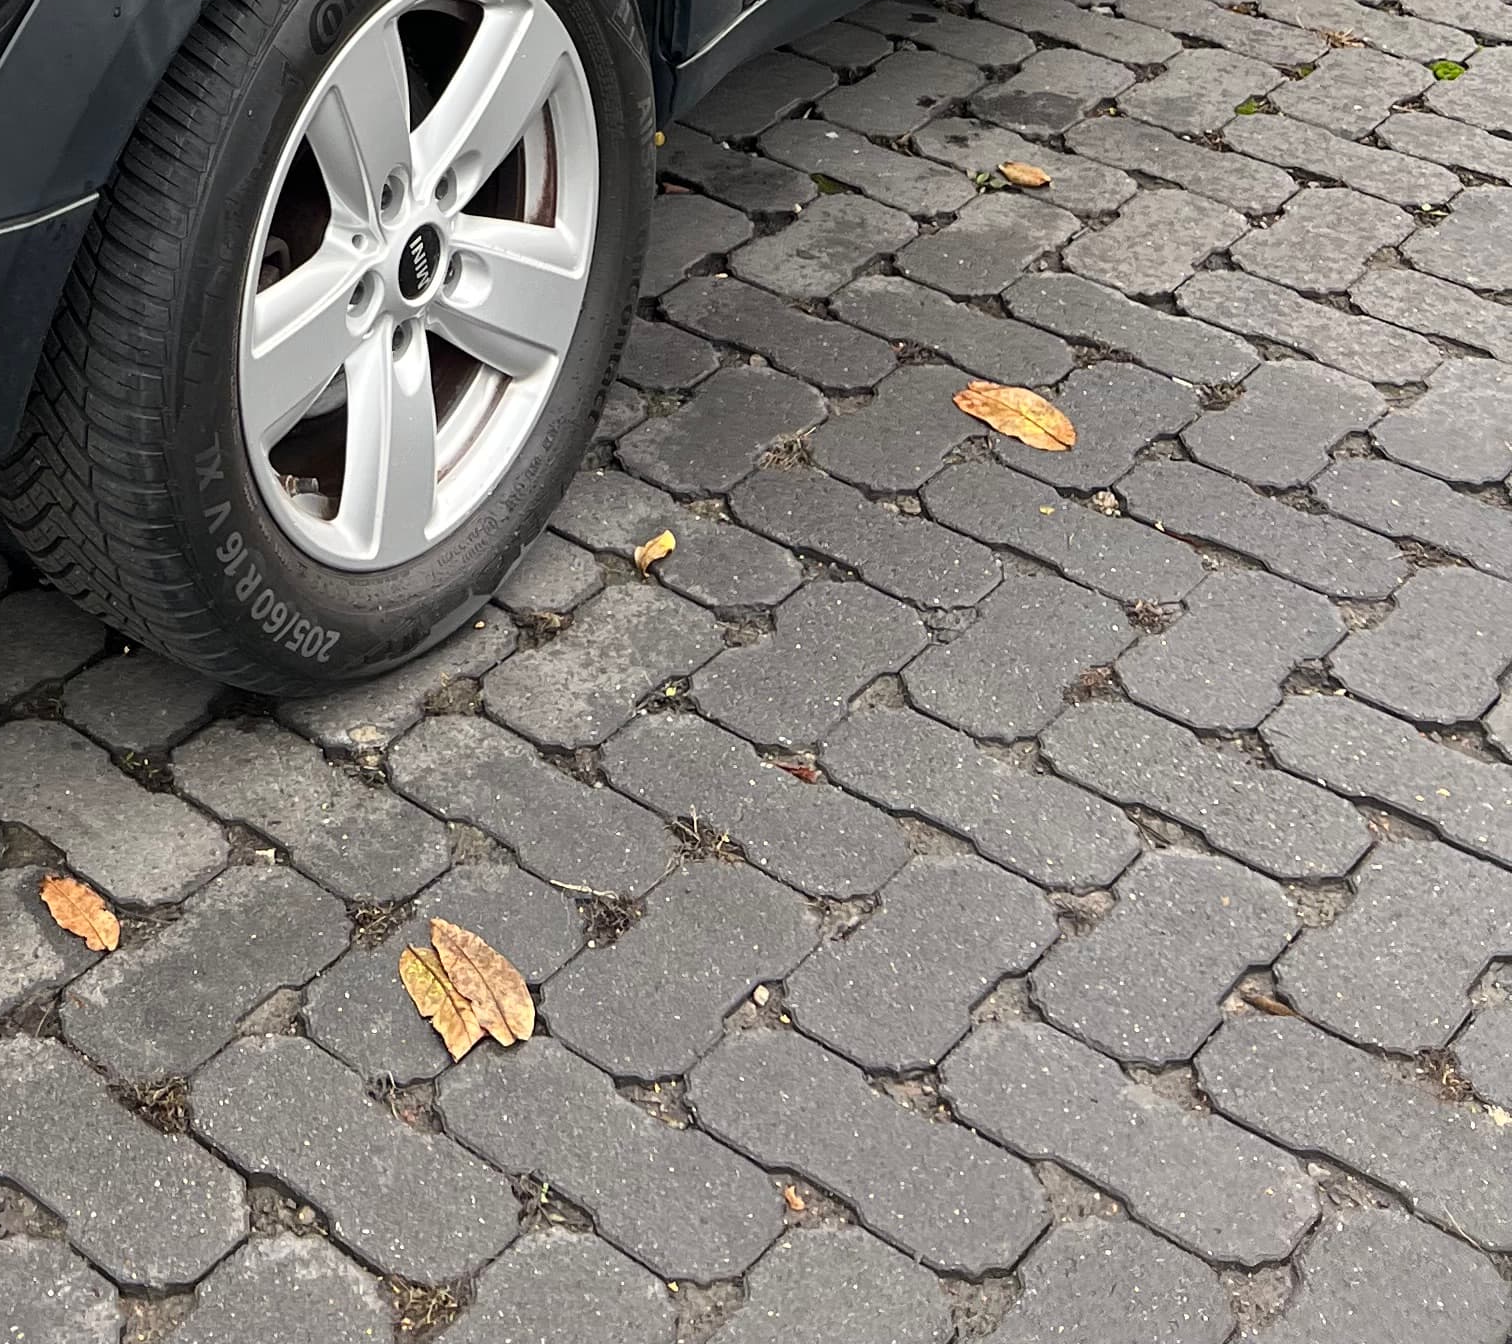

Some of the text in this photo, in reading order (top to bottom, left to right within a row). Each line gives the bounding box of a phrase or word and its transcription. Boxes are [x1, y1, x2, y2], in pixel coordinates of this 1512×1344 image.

[409, 235, 431, 290] MINI
[205, 500, 231, 534] V
[251, 588, 340, 663] 205/60
